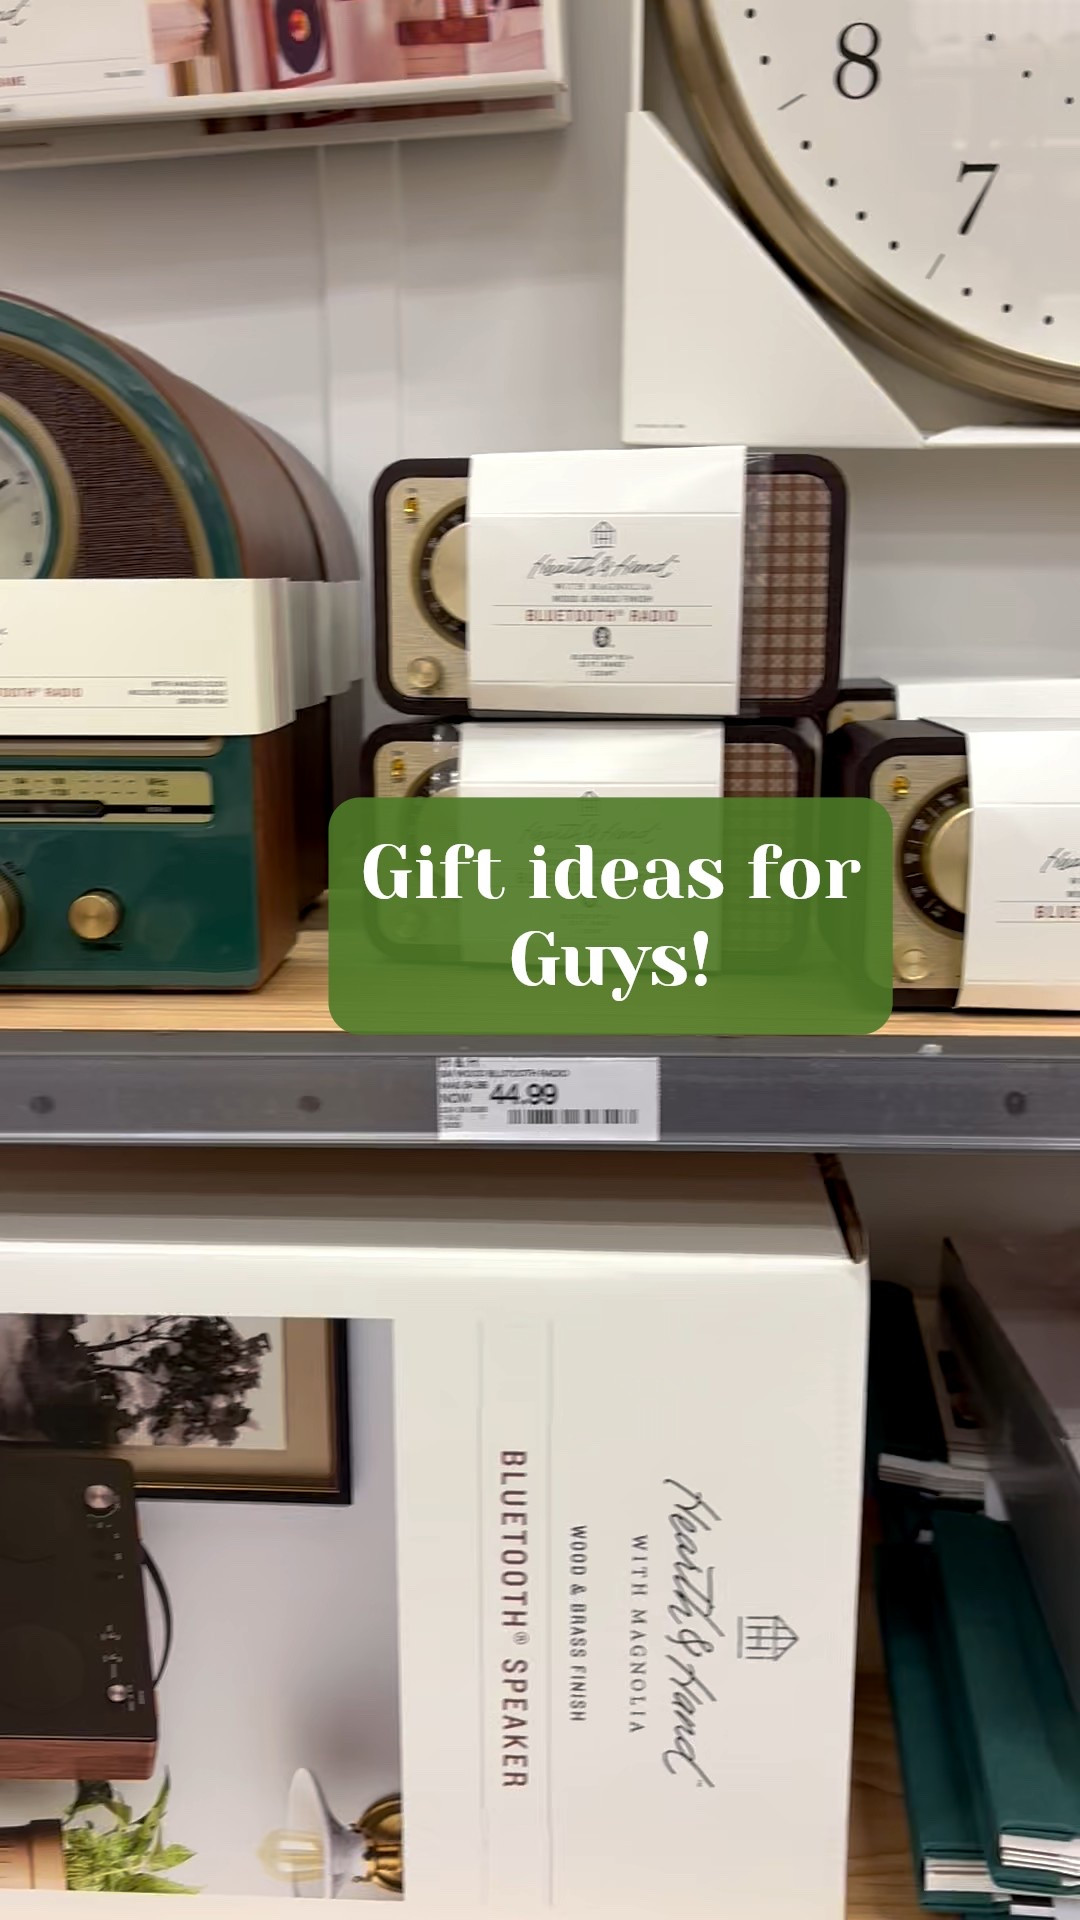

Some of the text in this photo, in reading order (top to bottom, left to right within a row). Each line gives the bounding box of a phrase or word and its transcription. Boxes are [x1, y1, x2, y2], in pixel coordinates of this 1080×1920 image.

[834, 22, 881, 100] 8
[958, 162, 999, 235] 7
[489, 1084, 558, 1105] 44.99
[501, 1451, 528, 1786] BLUETOOTH® SPEAKER
[570, 1526, 587, 1720] WOOD & BRASS FINISH
[630, 1535, 648, 1732] WITH MAGNOLIA
[662, 1477, 726, 1788] Hearth & Hand
